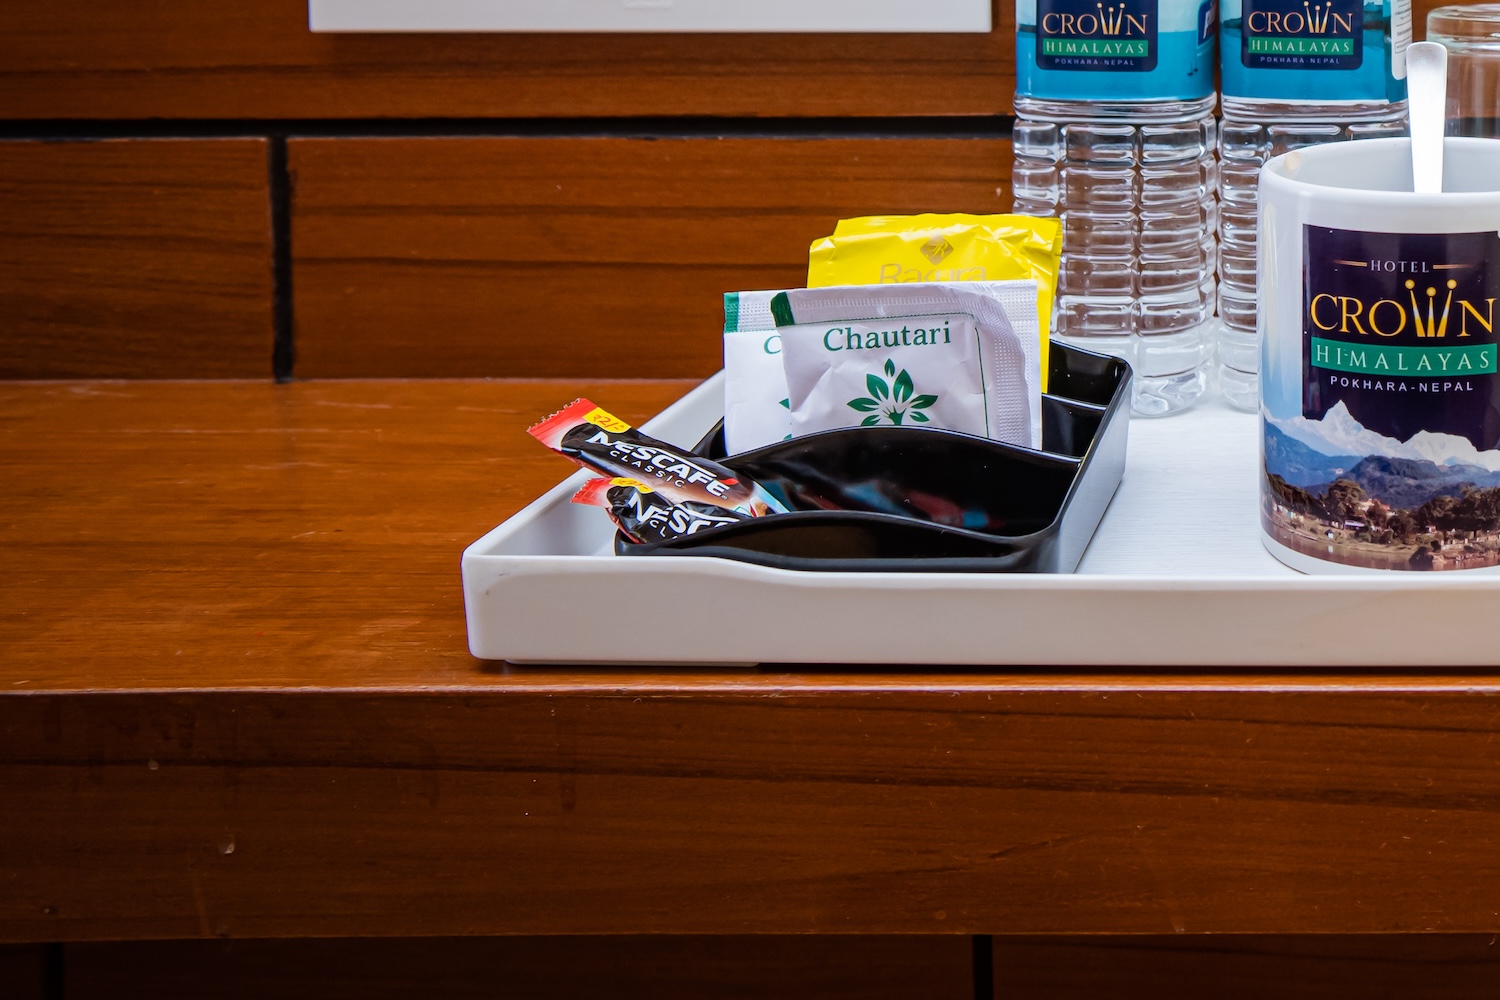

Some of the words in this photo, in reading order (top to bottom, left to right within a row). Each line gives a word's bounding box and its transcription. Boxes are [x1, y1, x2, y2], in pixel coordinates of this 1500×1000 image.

[1042, 2, 1148, 35] CROWN
[1248, 1, 1353, 34] CROWN
[1046, 41, 1144, 54] HIMALAYAS
[1251, 40, 1350, 53] HIMALAYAS
[1055, 58, 1134, 66] POKHARA-NEPAL
[1370, 259, 1430, 273] HOTEL
[1310, 279, 1497, 338] CROWN
[823, 320, 951, 351] Chautari
[1316, 344, 1489, 371] HIMALAYAS
[1330, 375, 1474, 393] POKHARA-NEPAL
[609, 450, 685, 488] CLASSIC
